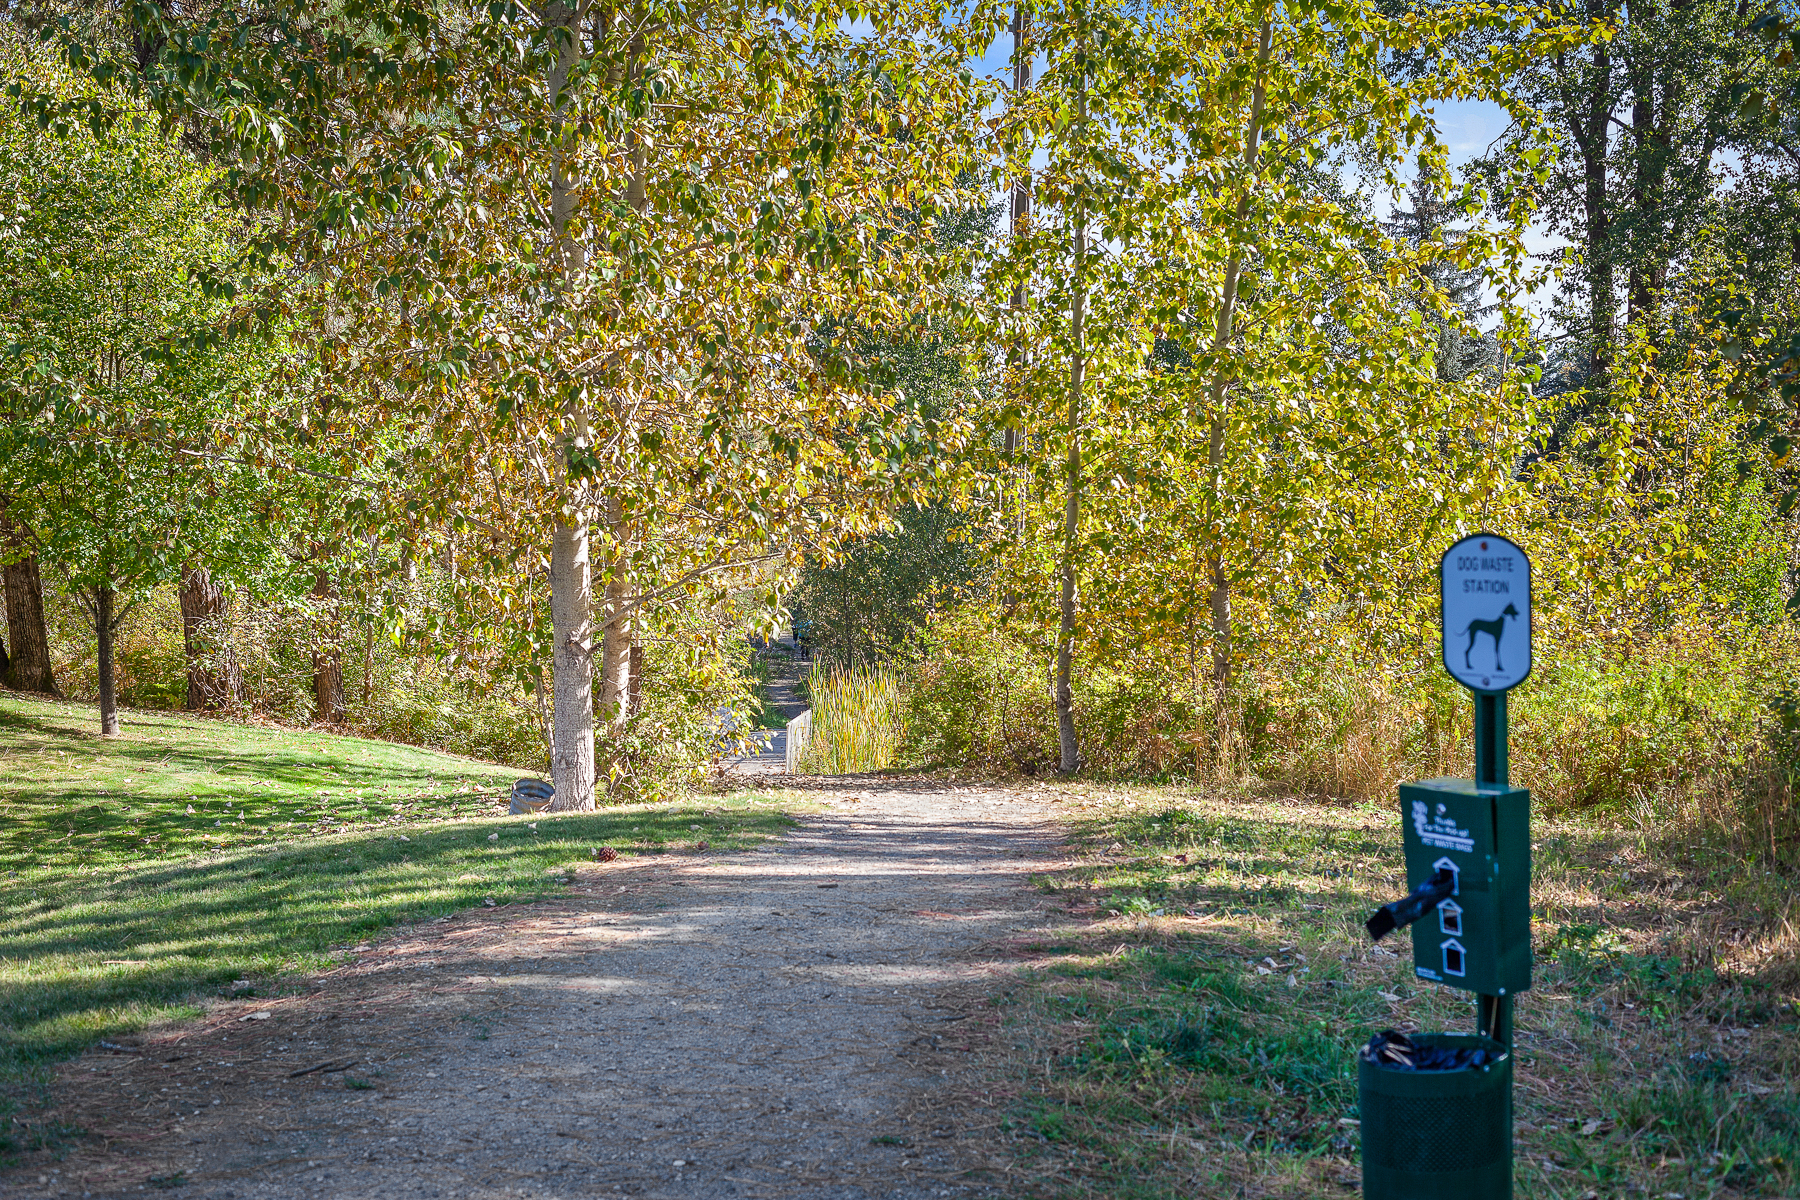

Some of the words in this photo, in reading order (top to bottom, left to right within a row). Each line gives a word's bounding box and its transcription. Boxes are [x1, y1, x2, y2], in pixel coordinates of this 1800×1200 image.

[1457, 556, 1479, 571] DOG
[1481, 556, 1514, 572] WASTE
[1463, 579, 1510, 594] STATION
